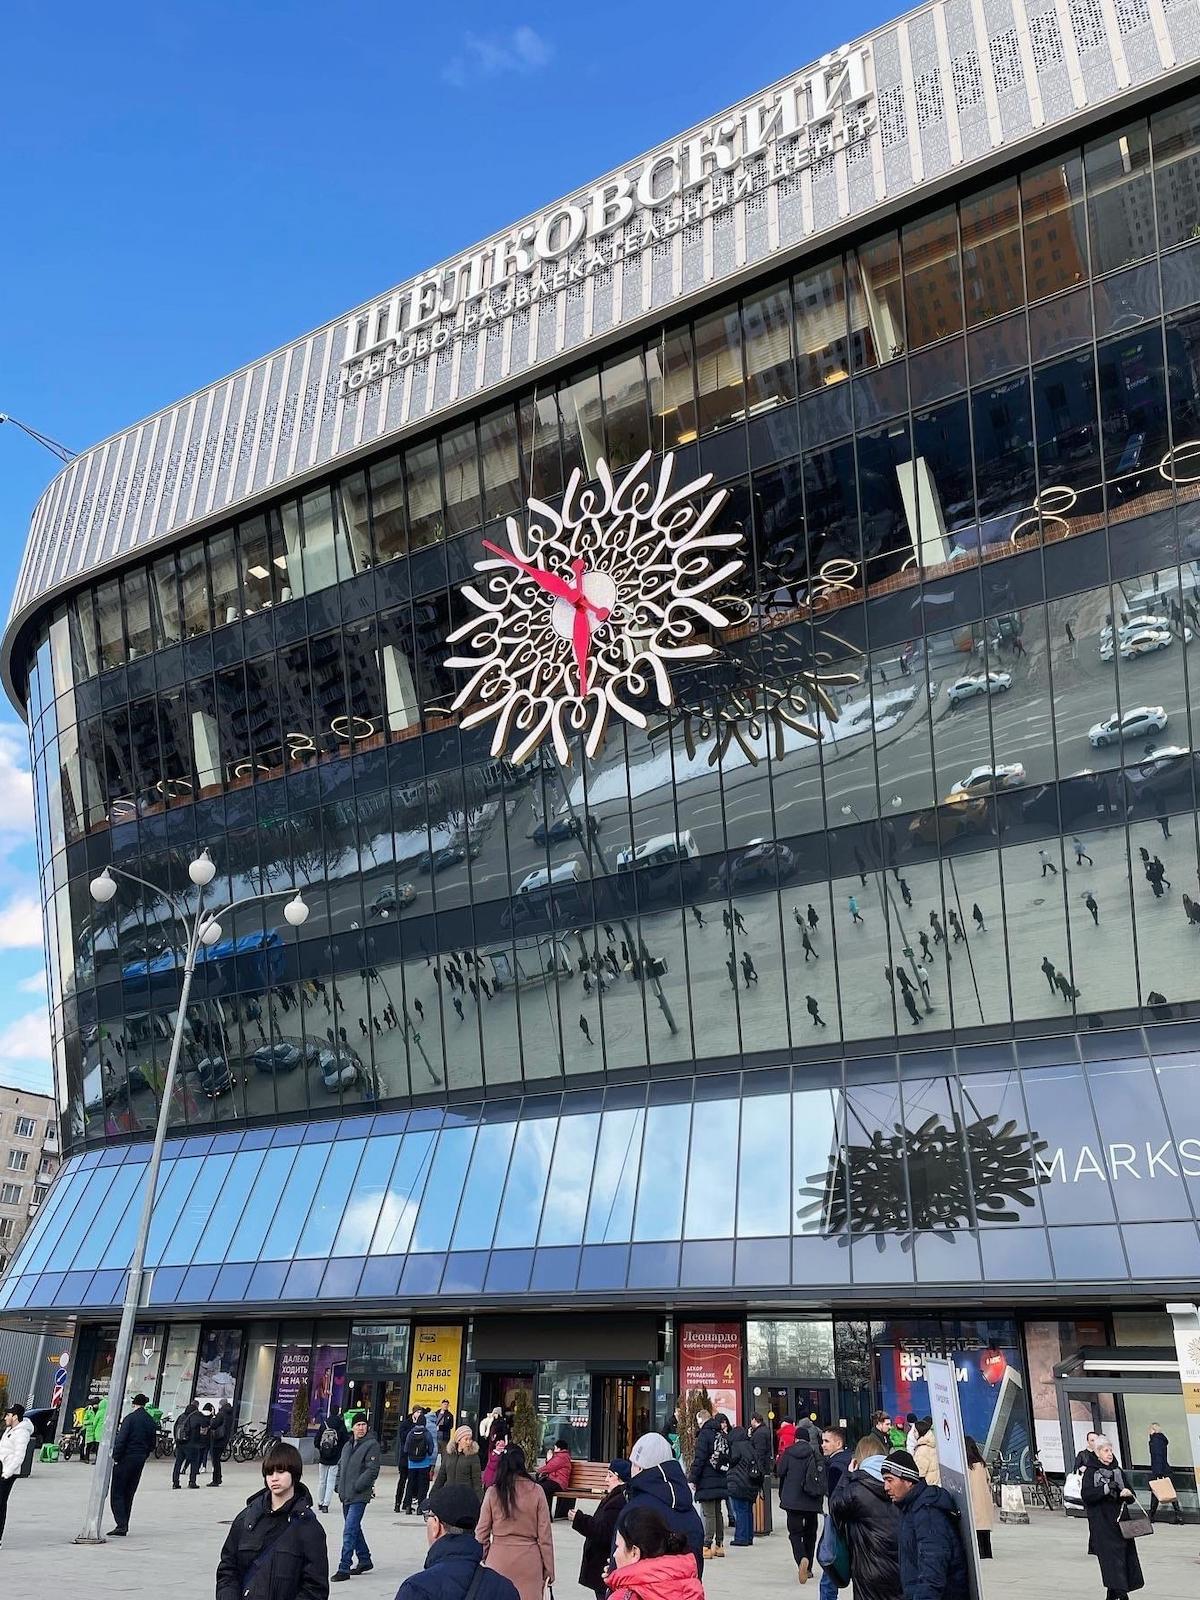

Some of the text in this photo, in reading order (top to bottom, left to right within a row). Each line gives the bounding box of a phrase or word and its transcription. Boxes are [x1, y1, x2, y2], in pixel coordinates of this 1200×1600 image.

[339, 44, 874, 367] ЩЁЛКОВСКИЙ
[339, 113, 877, 398] ТОРГОВО-РАЗВЛЕКАТЕЛЬНЫЙ ЦЕНТР
[1032, 1138, 1200, 1184] MARKS
[683, 1331, 738, 1343] Леонардо
[282, 1354, 310, 1364] ДАЛЕКО
[418, 1352, 442, 1362] У нас
[281, 1366, 309, 1375] ХОДИТЬ
[416, 1369, 451, 1379] для вас
[723, 1363, 734, 1379] 4
[901, 1368, 969, 1382] КРИ
[280, 1376, 290, 1385] НЕ
[416, 1383, 447, 1392] планы
